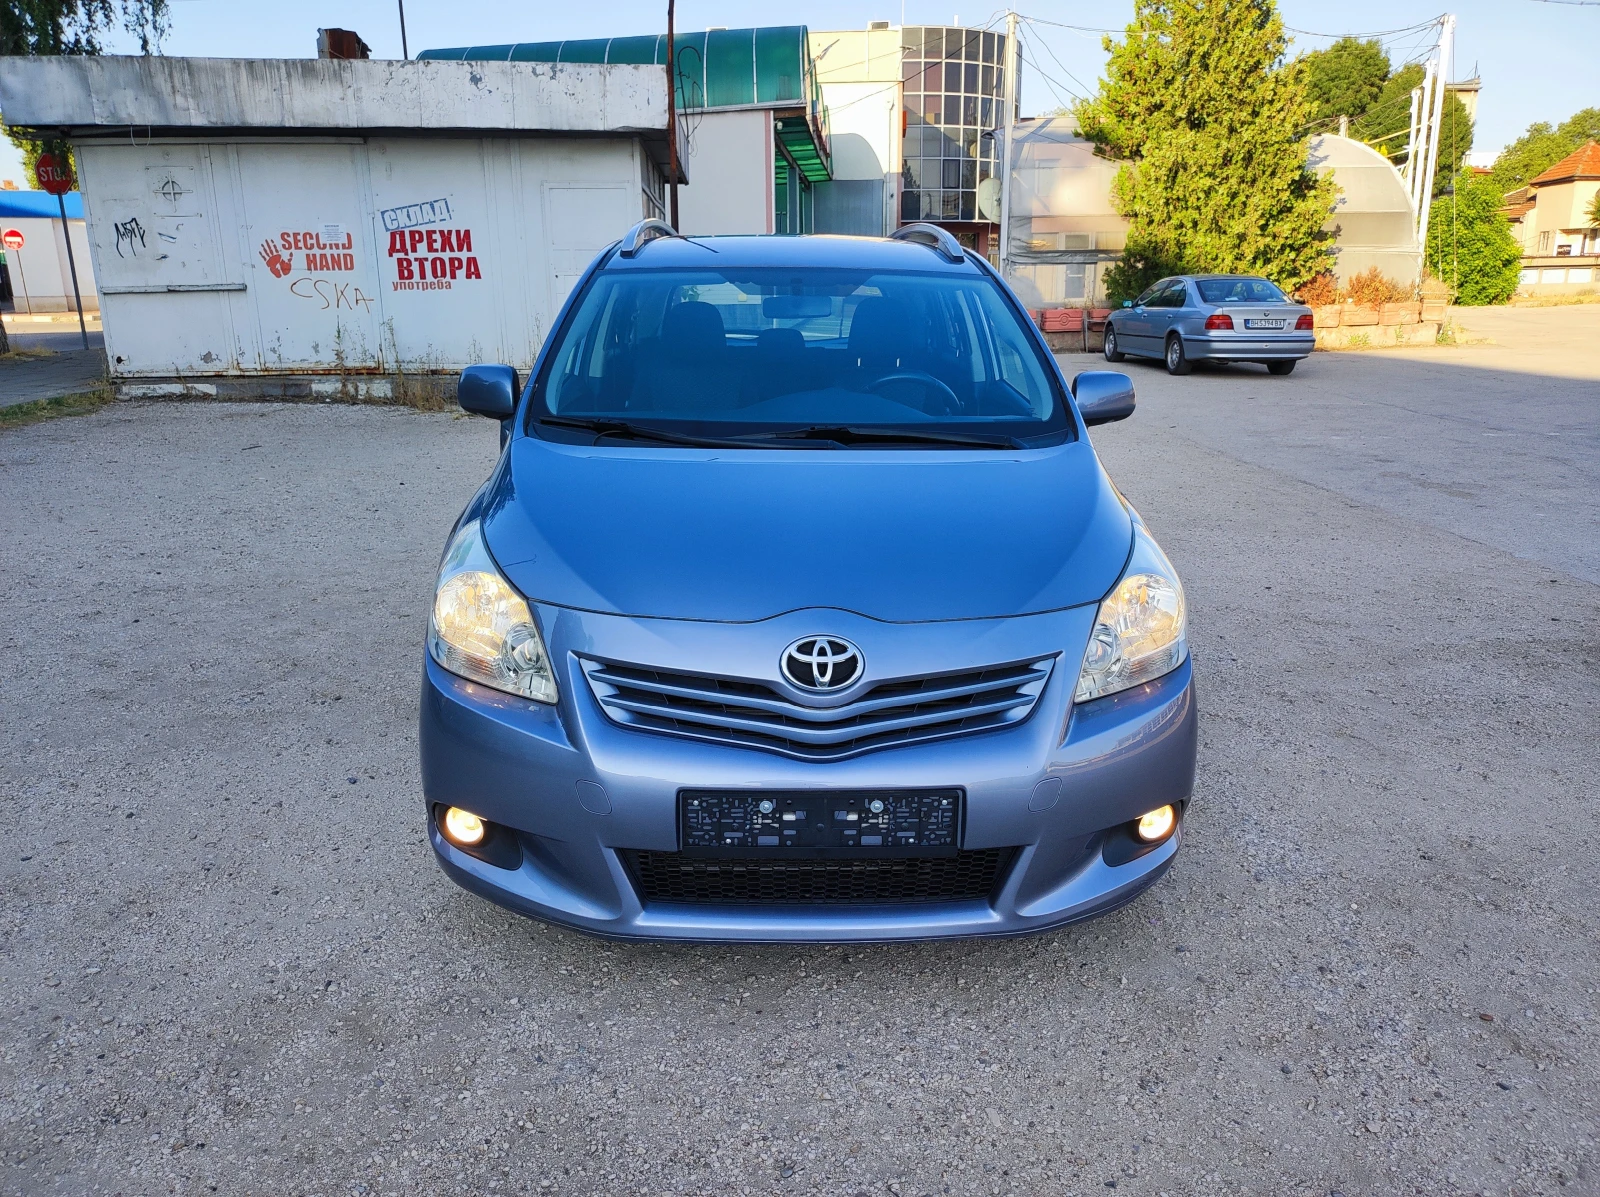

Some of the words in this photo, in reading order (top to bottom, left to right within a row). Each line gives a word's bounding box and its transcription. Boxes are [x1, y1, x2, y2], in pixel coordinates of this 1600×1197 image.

[39, 166, 70, 182] STO
[383, 201, 448, 230] СКЛАД
[388, 229, 473, 257] ДРЕХИ
[305, 253, 355, 271] HAND
[396, 256, 482, 281] ВТОРА
[290, 277, 375, 314] CSKA
[392, 279, 452, 291] употреба
